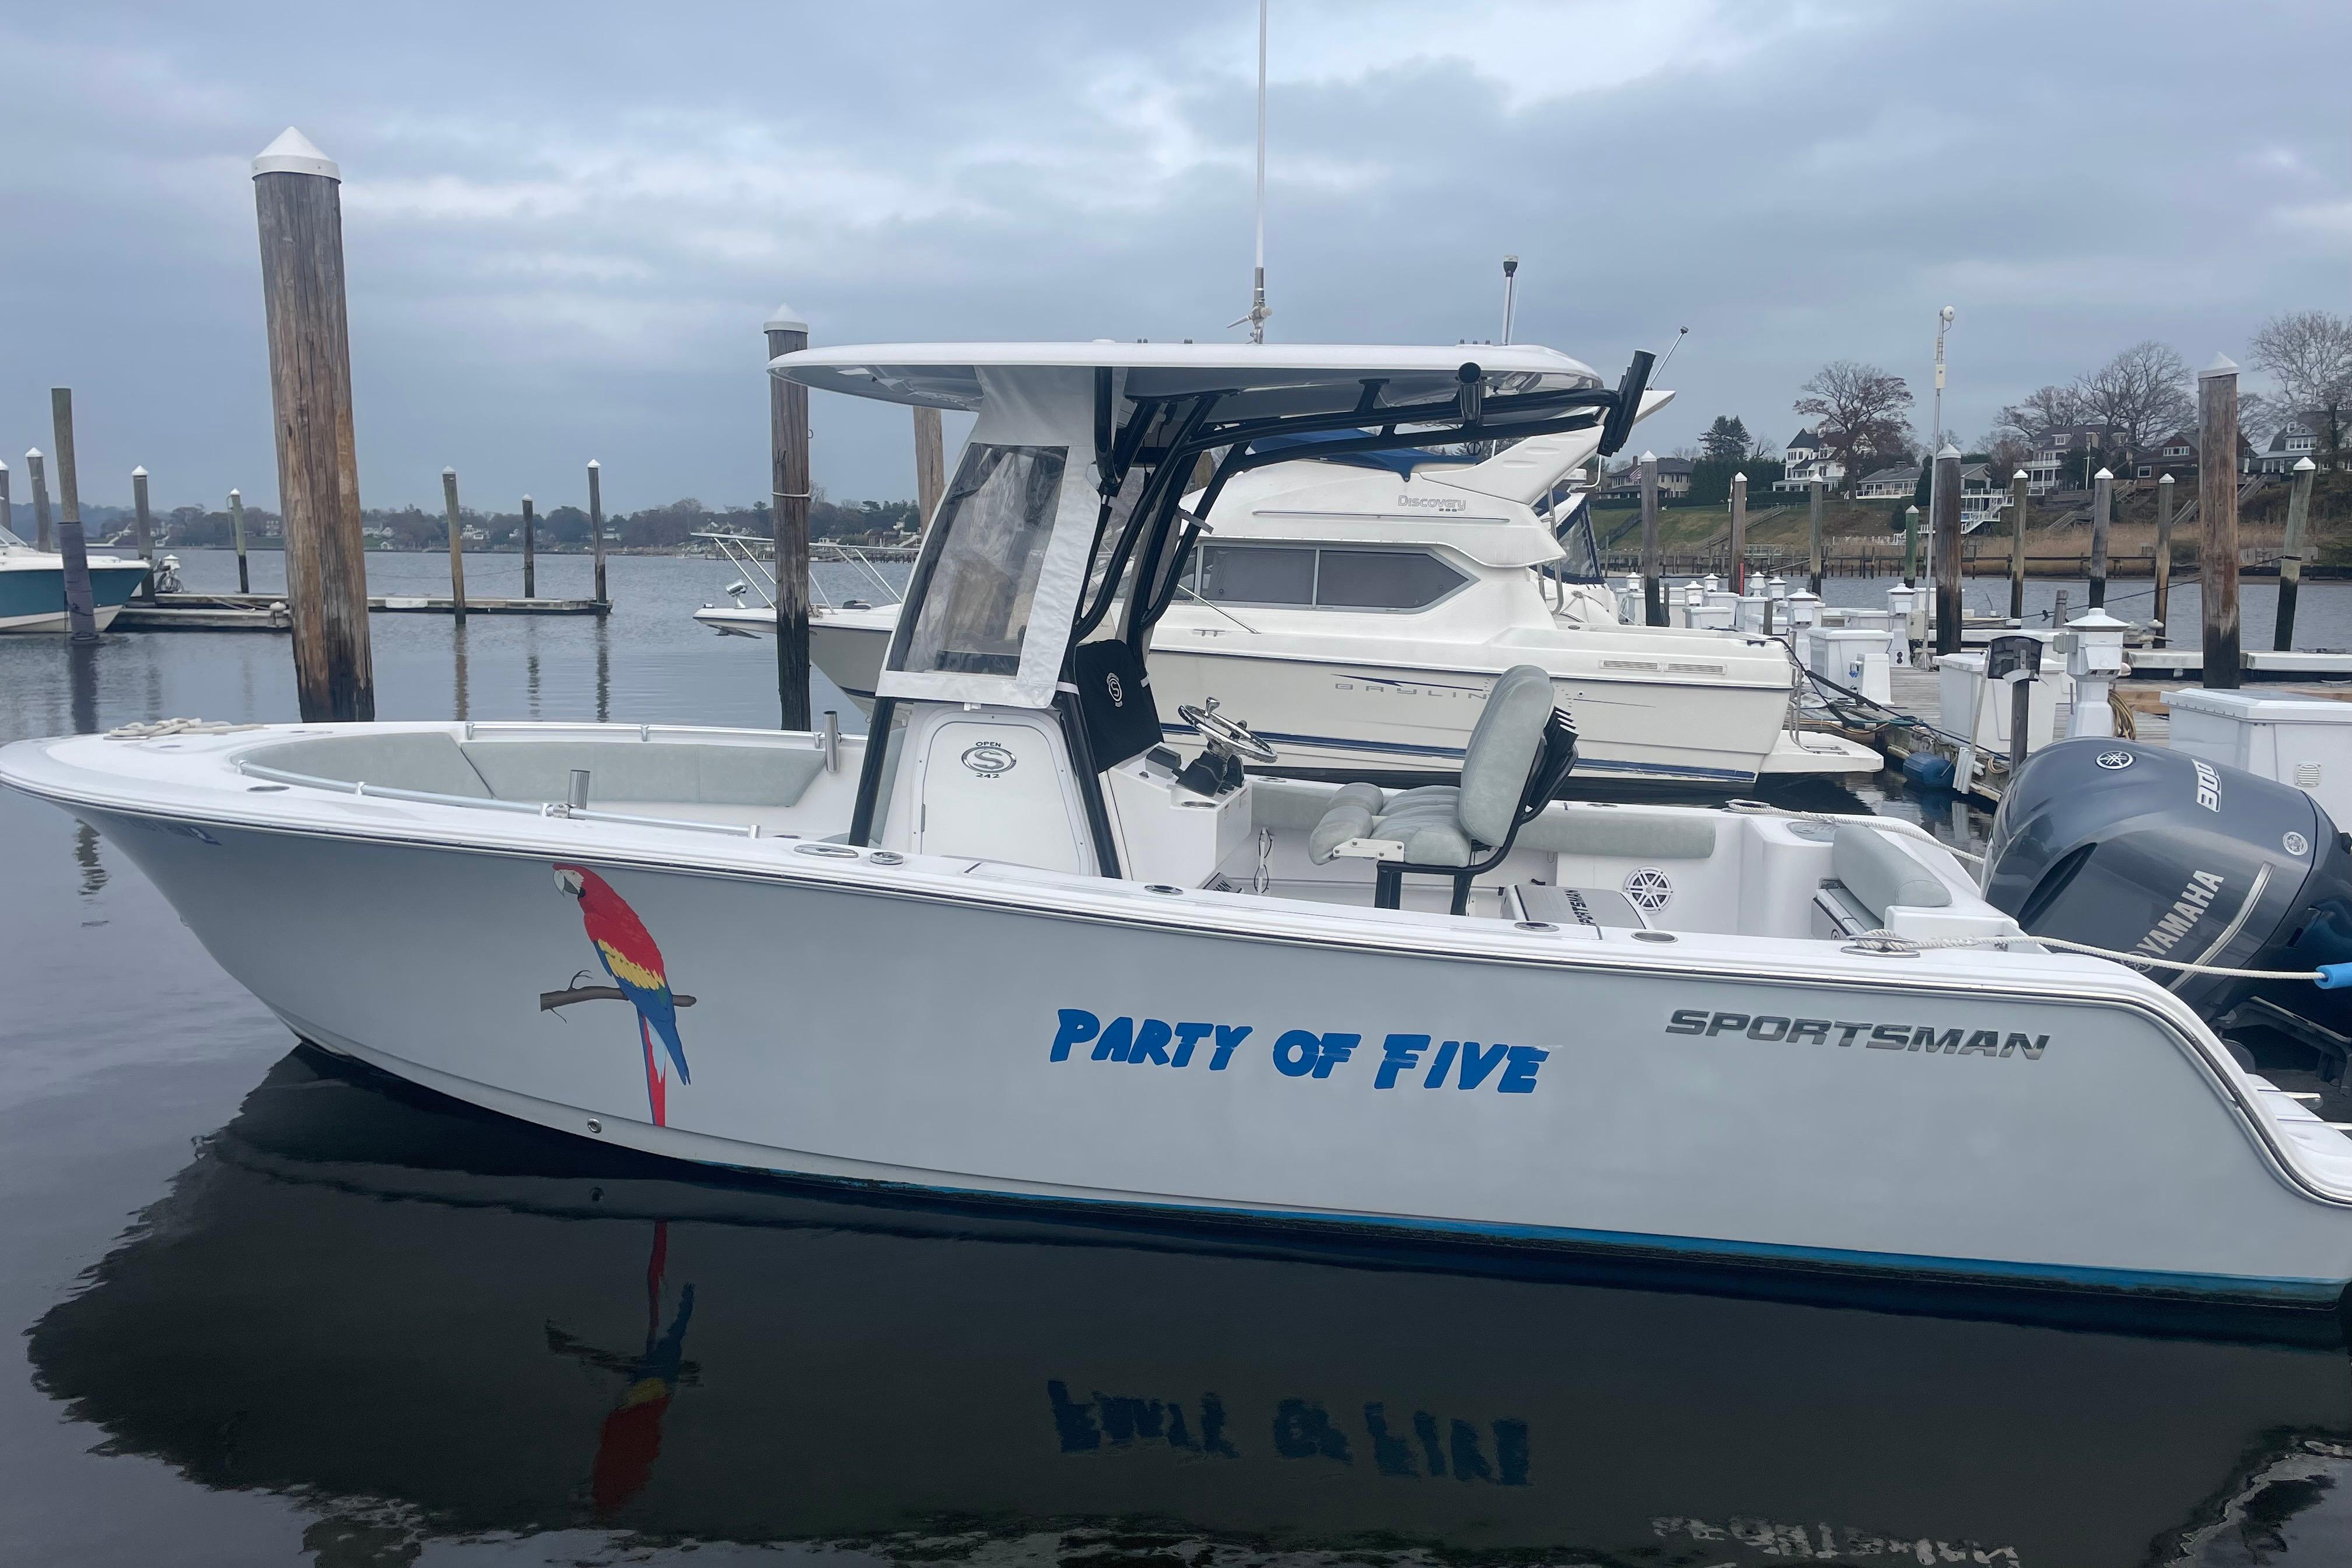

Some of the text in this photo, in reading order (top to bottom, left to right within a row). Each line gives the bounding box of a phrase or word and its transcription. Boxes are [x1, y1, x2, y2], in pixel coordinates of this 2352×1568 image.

[1398, 495, 1466, 511] Discovery
[1335, 683, 1487, 700] BAYLIN
[2191, 758, 2222, 813] 300
[2136, 870, 2224, 956] YAMAHA
[1050, 1009, 1550, 1094] PARTY OF FIVE
[1665, 1009, 2051, 1060] SPORTSMAN
